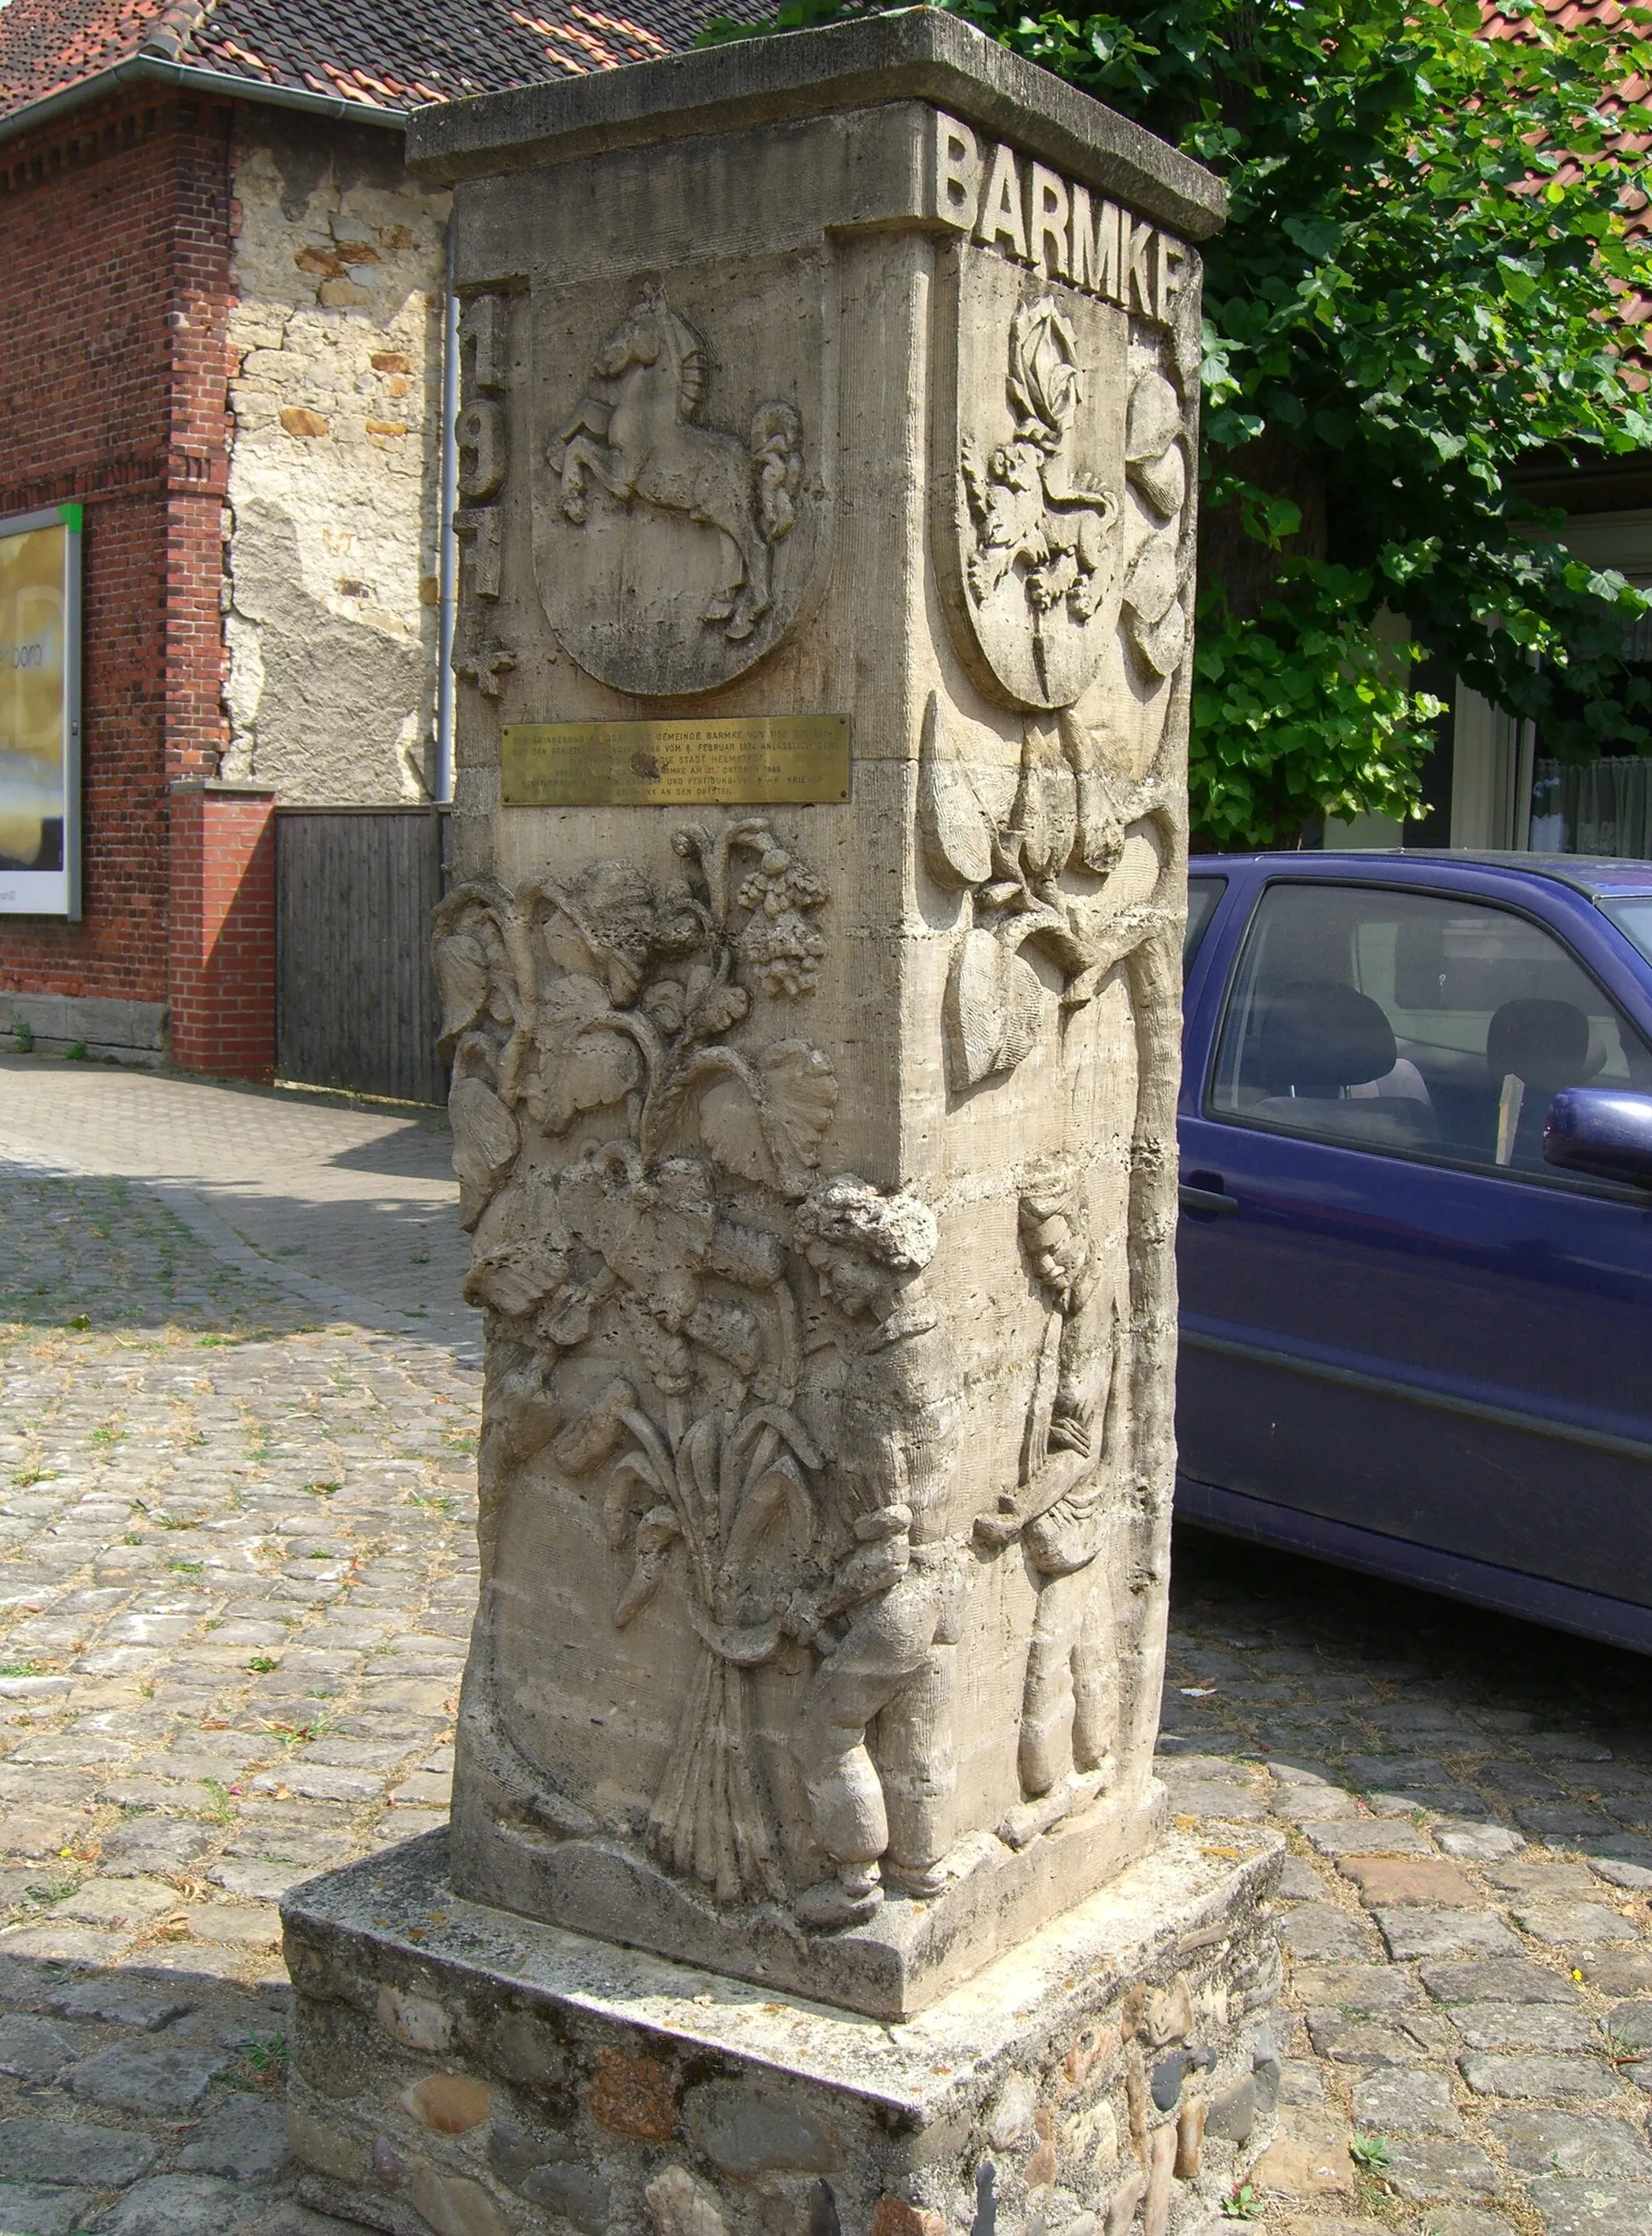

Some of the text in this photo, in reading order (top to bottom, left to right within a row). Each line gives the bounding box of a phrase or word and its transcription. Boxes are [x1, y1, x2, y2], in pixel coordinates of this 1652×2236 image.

[937, 111, 1187, 326] BARMKE
[657, 732, 701, 741] GEMEINDE
[707, 730, 743, 740] BARMKE
[665, 744, 682, 753] VOM
[698, 743, 735, 752] FEBRUAR
[679, 755, 706, 765] STADT
[690, 766, 703, 775] AM
[667, 777, 683, 786] UND
[661, 788, 671, 796] AN
[676, 787, 691, 796] DEN
